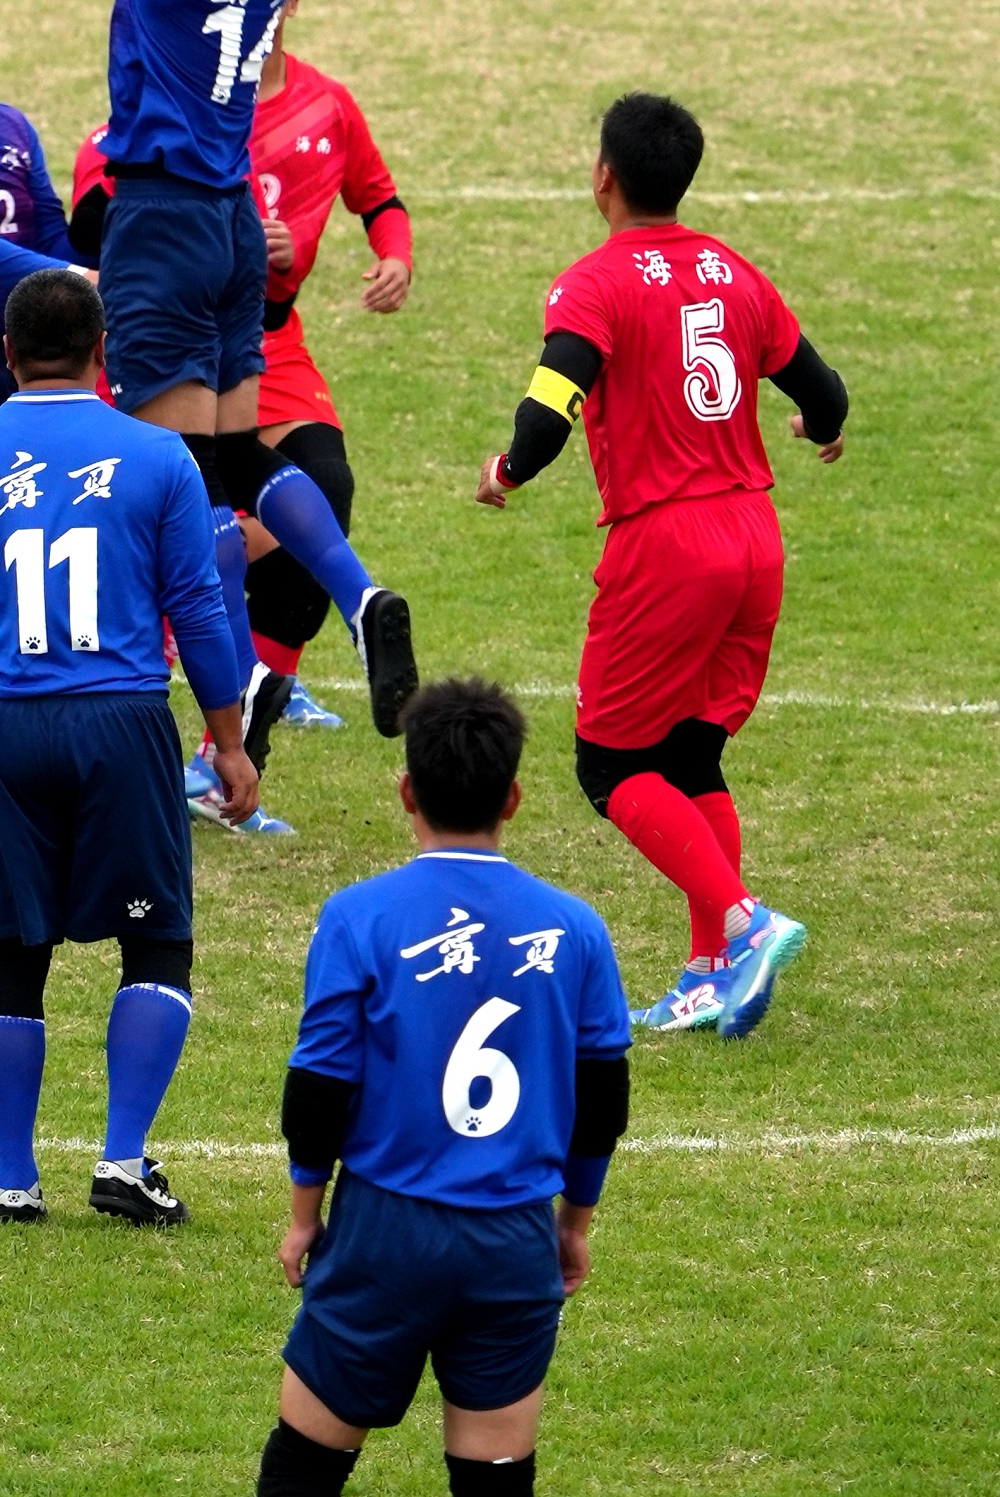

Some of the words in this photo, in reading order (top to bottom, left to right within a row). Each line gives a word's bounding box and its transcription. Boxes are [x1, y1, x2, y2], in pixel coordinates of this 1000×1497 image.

[632, 248, 734, 287] 海南
[680, 297, 742, 422] 5
[3, 526, 100, 655] 11
[442, 996, 522, 1138] 6
